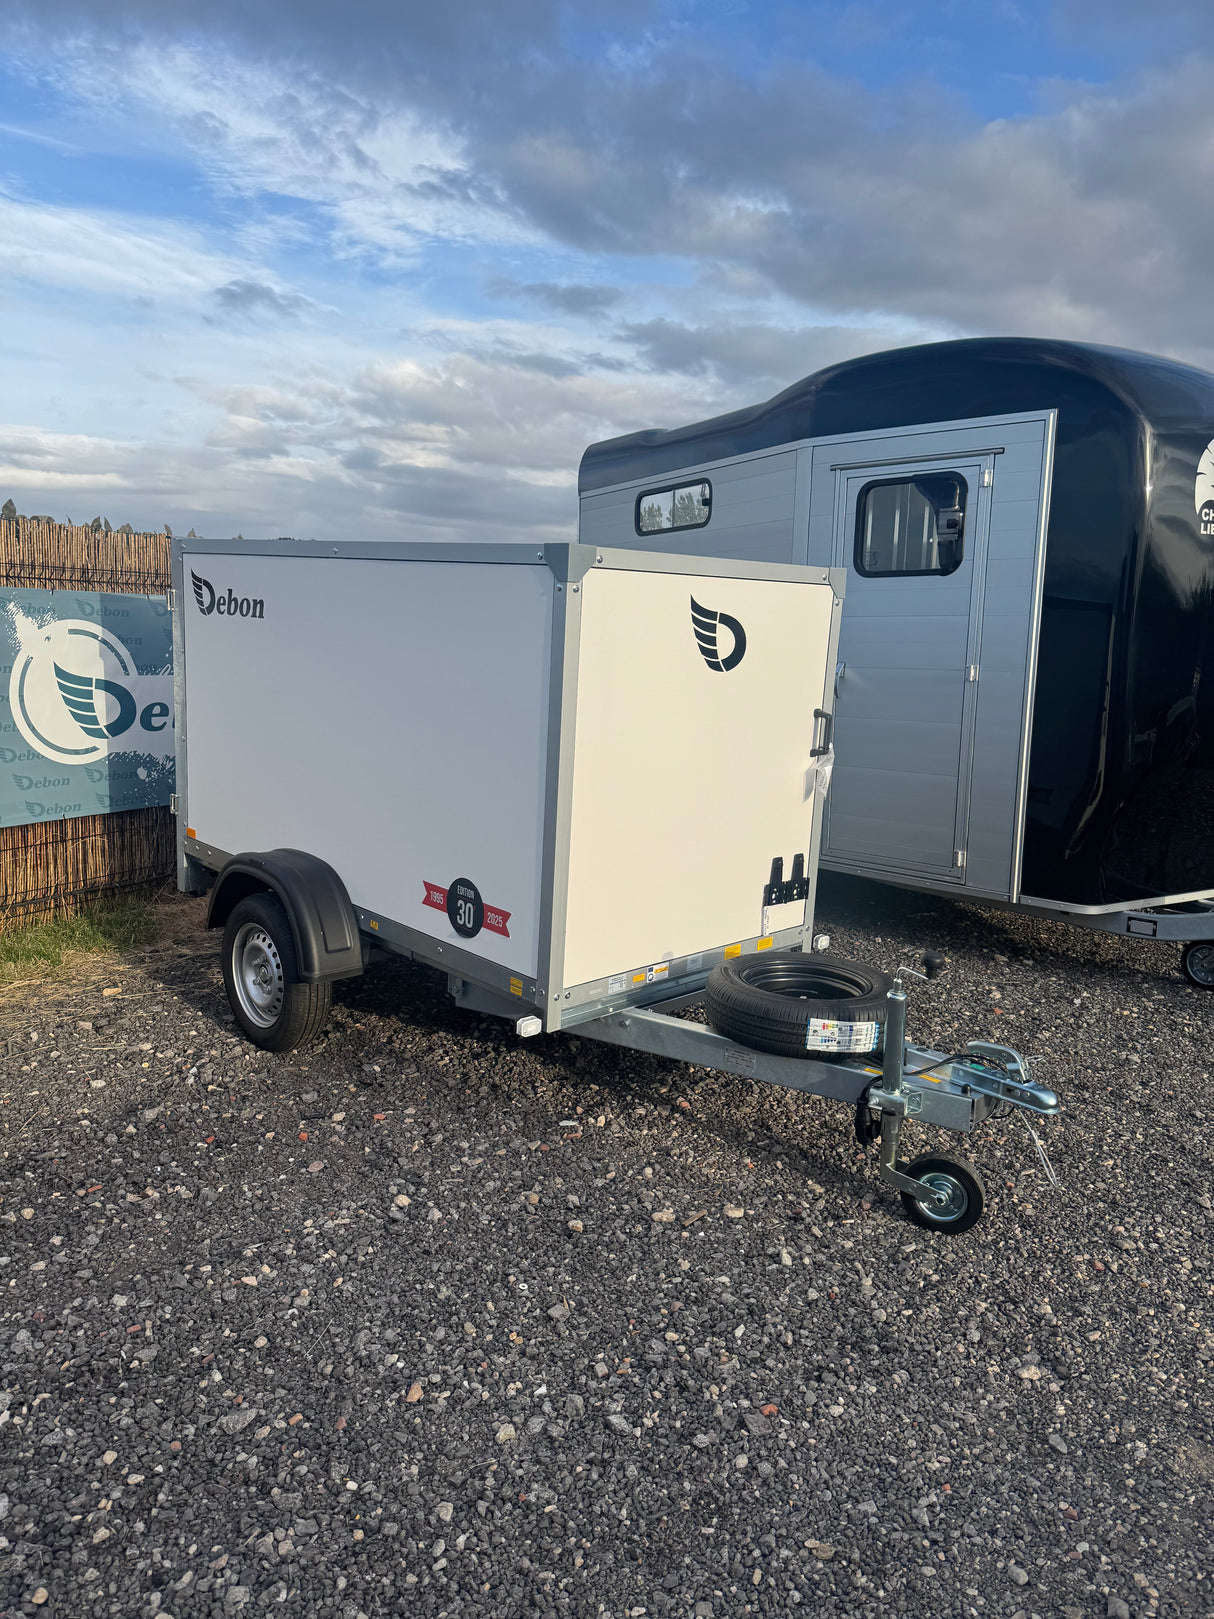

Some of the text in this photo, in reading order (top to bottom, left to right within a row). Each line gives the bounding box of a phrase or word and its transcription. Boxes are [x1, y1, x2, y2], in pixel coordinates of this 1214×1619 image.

[191, 568, 264, 618] Debon
[76, 598, 129, 617] Debon
[53, 661, 176, 740] De
[12, 772, 71, 791] Debon
[25, 800, 82, 818] Debon
[430, 890, 444, 905] 1995
[457, 885, 475, 900] EDITION
[456, 899, 474, 929] 30
[487, 911, 503, 928] 2025
